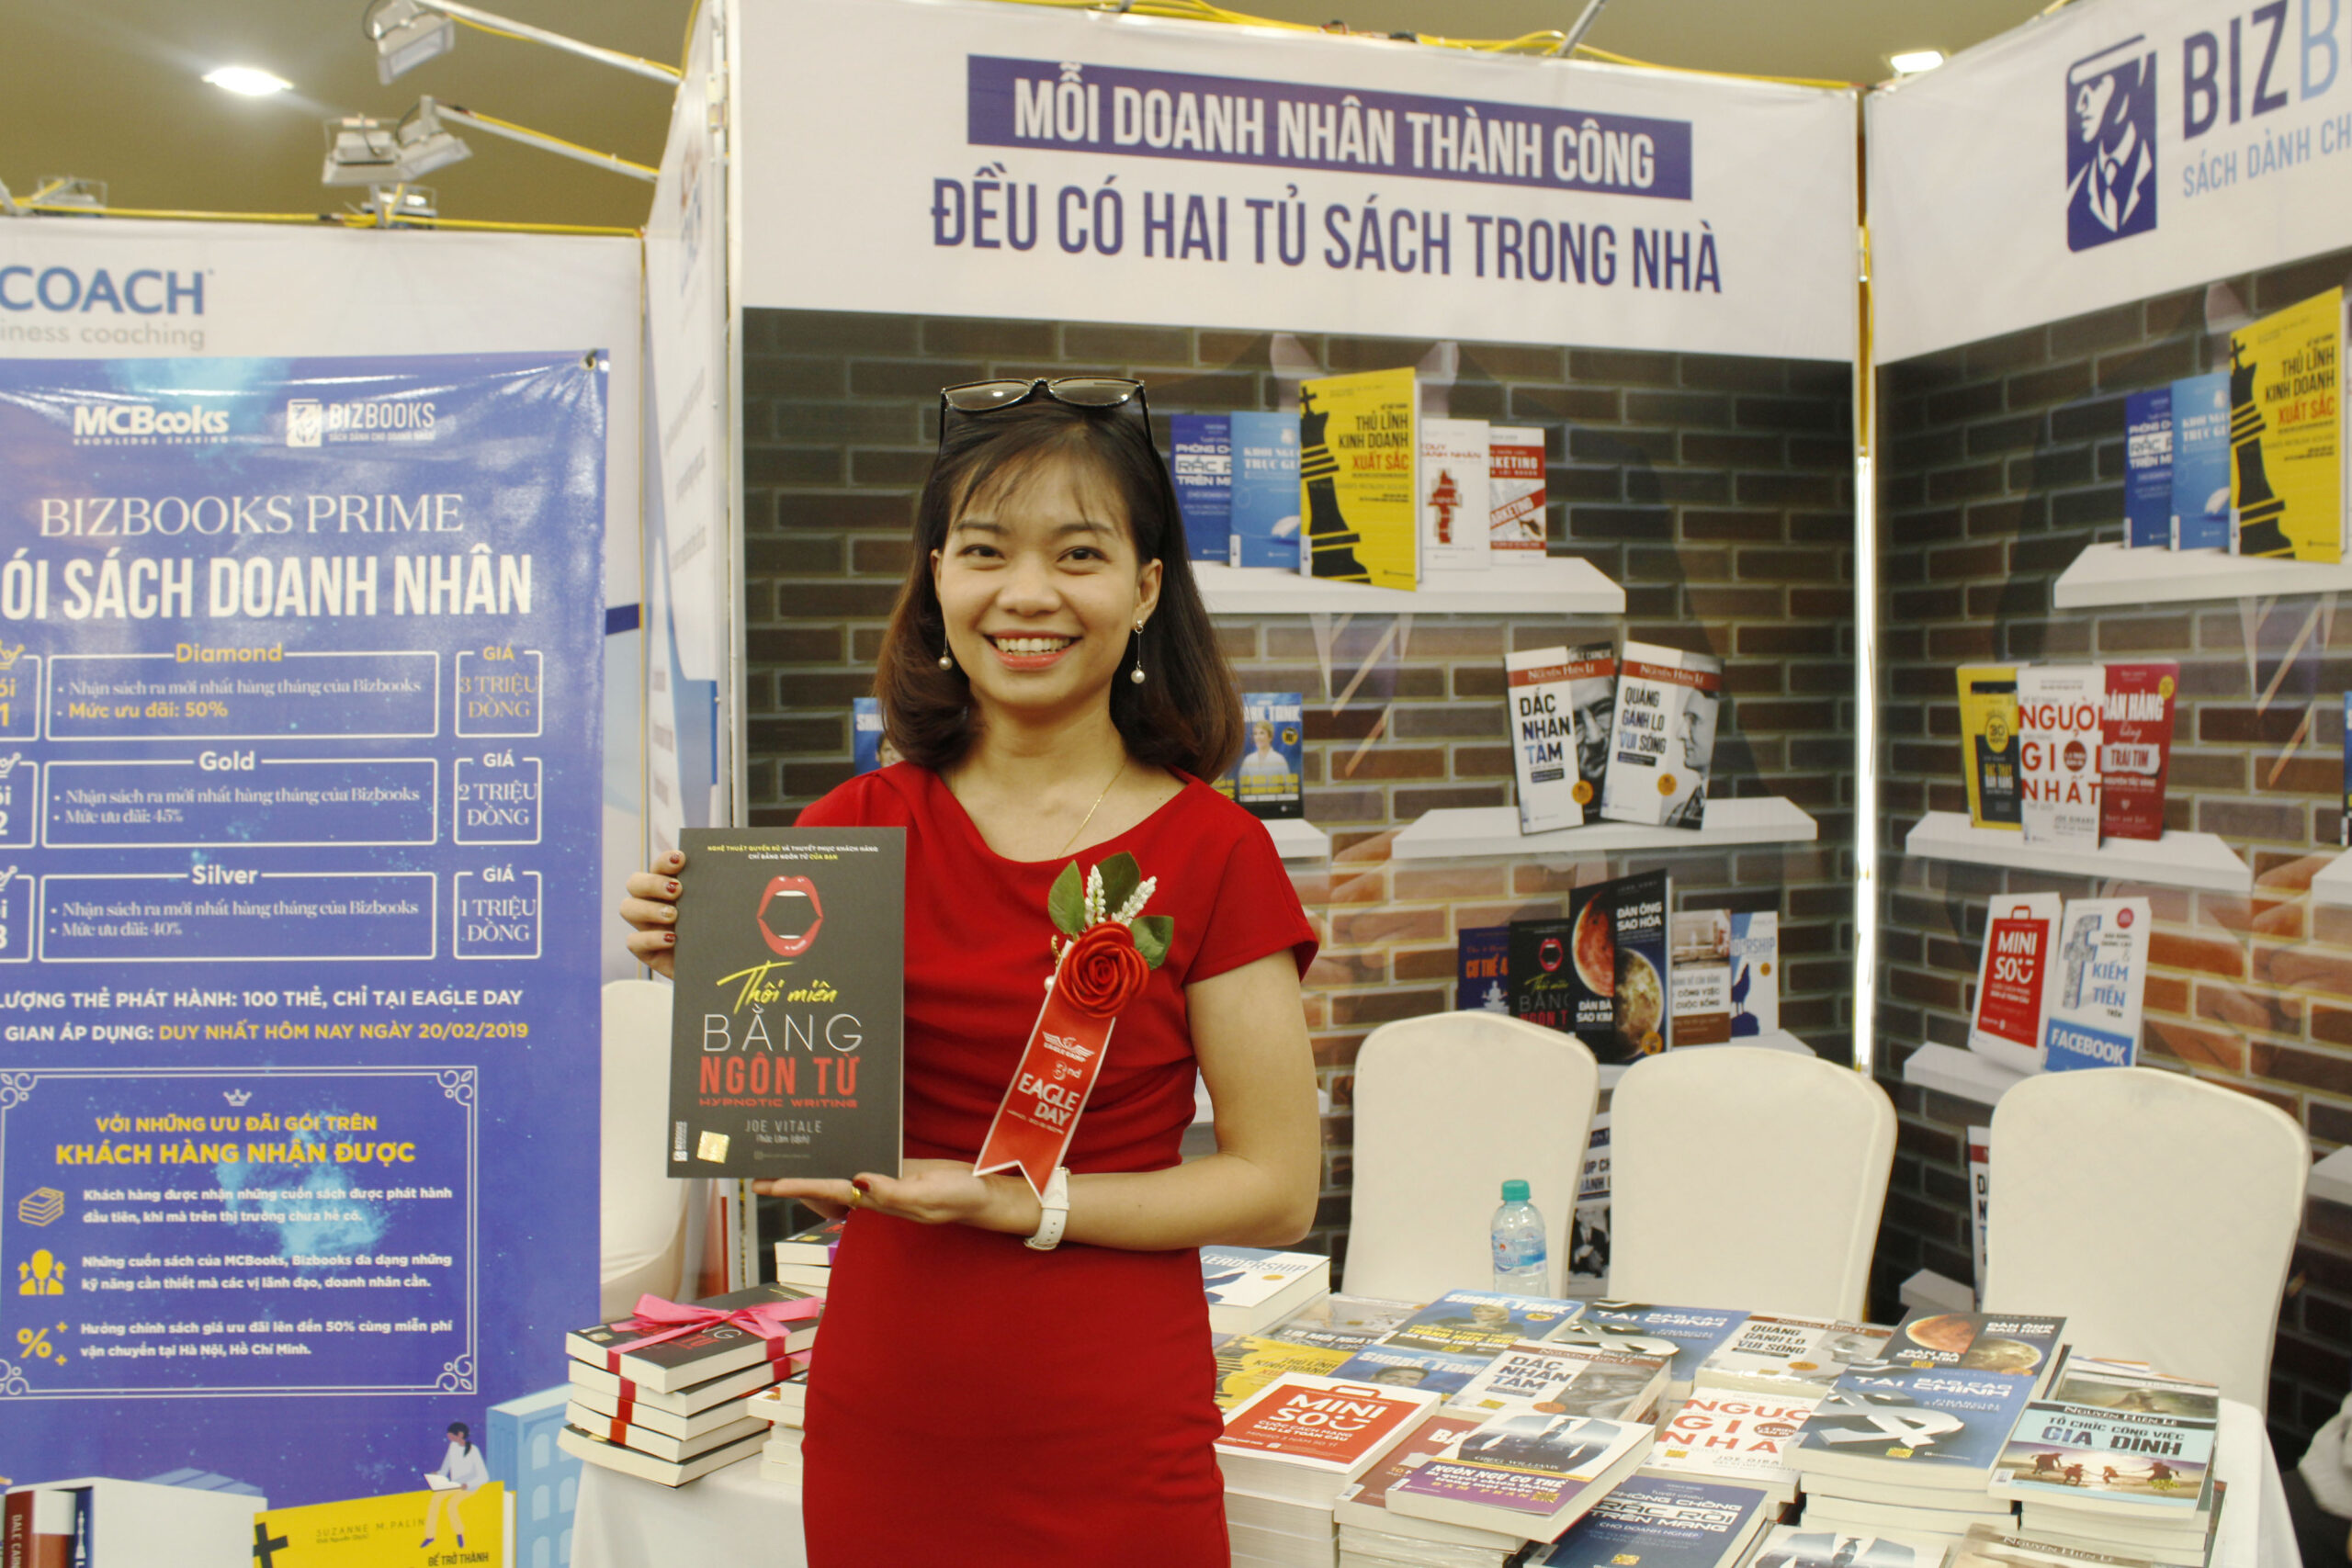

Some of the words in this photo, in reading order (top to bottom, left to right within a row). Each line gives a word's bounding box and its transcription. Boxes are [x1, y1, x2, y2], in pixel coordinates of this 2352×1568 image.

[1013, 62, 1100, 143] MỖI
[1113, 85, 1265, 156] DOANH
[1278, 95, 1395, 167] NHÂN
[1407, 107, 1542, 179] THÀNH
[1553, 118, 1654, 189] CÔNG
[2183, 149, 2237, 198] SÁCH
[2248, 128, 2311, 180] DÀNH
[931, 161, 1039, 253] ĐỀU
[1057, 174, 1123, 257] CÓ
[1143, 191, 1229, 264] HAI
[1246, 184, 1306, 268] TỦ
[1324, 194, 1450, 277] SÁCH
[1465, 213, 1617, 287] TRONG
[1633, 220, 1722, 294] NHÀ
[0, 266, 205, 315] COACH
[80, 322, 205, 351] coaching
[74, 406, 229, 436] MCBooks
[329, 401, 435, 429] BIZBOOKS
[1356, 411, 1378, 431] THỦ
[1381, 411, 1408, 430] LĨNH
[1339, 434, 1365, 448] KINH
[1368, 432, 1408, 448] DOANH
[1352, 450, 1383, 470] XUẤT
[1385, 447, 1408, 469] SẮC
[40, 495, 293, 536] BIZBOOKS
[307, 493, 464, 533] PRIME
[63, 547, 193, 620] SÁCH
[209, 554, 377, 617] DOANH
[394, 542, 531, 615] NHÂN
[175, 643, 283, 662] Diamond
[483, 646, 514, 660] GIÁ
[69, 680, 110, 698] Nhận
[113, 678, 146, 695] sách
[150, 683, 166, 695] ra
[168, 678, 197, 695] mới
[199, 677, 233, 694] nhất
[237, 678, 275, 697] hàng
[277, 678, 321, 696] tháng
[323, 679, 350, 694] của
[353, 678, 422, 694] Bizbooks
[459, 678, 471, 694] 3
[474, 672, 539, 697] TRIỆU
[69, 701, 108, 718] Mức
[114, 702, 140, 718] ưu
[145, 701, 180, 717] đãi:
[185, 701, 228, 718] 50%
[1521, 713, 1571, 740] NHÂN
[199, 750, 255, 771] Gold
[483, 749, 514, 767] GIÁ
[1524, 739, 1563, 764] TÂM
[458, 783, 469, 800] 2
[473, 779, 537, 806] TRIỆU
[2021, 774, 2102, 805] NHẤT
[191, 864, 258, 885] Silver
[483, 863, 514, 883] GIÁ
[460, 899, 468, 917] 1
[471, 895, 537, 919] TRIỆU
[1997, 931, 2038, 955] MINI
[72, 987, 110, 1008] THẺ
[116, 988, 168, 1008] PHÁT
[180, 988, 238, 1007] HÀNH:
[243, 991, 278, 1007] 100
[283, 986, 328, 1009] THẺ,
[333, 985, 368, 1007] CHỈ
[373, 990, 406, 1010] TẠI
[412, 990, 478, 1006] EAGLE
[483, 990, 524, 1006] DAY
[717, 961, 796, 1014] Thôi
[787, 980, 838, 1004] miên
[5, 1025, 54, 1042] GIAN
[59, 1021, 87, 1042] ÁP
[92, 1025, 154, 1044] DỤNG:
[159, 1024, 200, 1041] DUY
[206, 1019, 259, 1040] NHẤT
[265, 1021, 310, 1040] HÔM
[315, 1023, 355, 1040] NAY
[359, 1020, 413, 1040] NGÀY
[418, 1022, 529, 1041] 20/02/2019
[704, 1004, 862, 1053] BẰNG
[2051, 1028, 2126, 1066] FACEBOOK
[699, 1052, 796, 1095] NGÔN
[813, 1052, 860, 1095] TỪ
[699, 1098, 784, 1108] HYPNOTIC
[791, 1099, 857, 1108] WRITING
[1017, 1073, 1080, 1111] EAGLE
[96, 1113, 130, 1133] VỚI
[135, 1112, 207, 1132] NHỮNG
[210, 1114, 241, 1131] ƯU
[245, 1112, 279, 1132] ĐÃI
[285, 1112, 318, 1131] GÓI
[324, 1112, 378, 1131] TRÊN
[1035, 1102, 1070, 1126] DAY
[745, 1120, 767, 1133] JOE
[775, 1120, 821, 1133] VITALE
[55, 1139, 153, 1165] KHÁCH
[160, 1139, 241, 1164] HÀNG
[247, 1138, 327, 1168] NHẬN
[334, 1141, 415, 1168] ĐƯỢC
[1201, 1255, 1309, 1273] LEADERSHIP
[1444, 1293, 1502, 1307] SHARK
[1514, 1297, 1573, 1315] TANK
[81, 1345, 105, 1359] vận
[107, 1340, 156, 1358] chuyển
[158, 1344, 176, 1358] tại
[179, 1342, 197, 1355] Hà
[200, 1343, 227, 1358] Nội,
[229, 1339, 248, 1355] Hồ
[251, 1343, 274, 1355] Chí
[277, 1344, 311, 1355] Minh.
[1286, 1394, 1388, 1418] MINI
[2041, 1426, 2093, 1446] GIA
[2109, 1434, 2182, 1455] ĐÌNH
[1610, 1491, 1672, 1504] PHÒNG
[1676, 1497, 1743, 1512] CHỐNG
[1590, 1509, 1653, 1524] TRÊN
[1657, 1518, 1728, 1532] MẠNG
